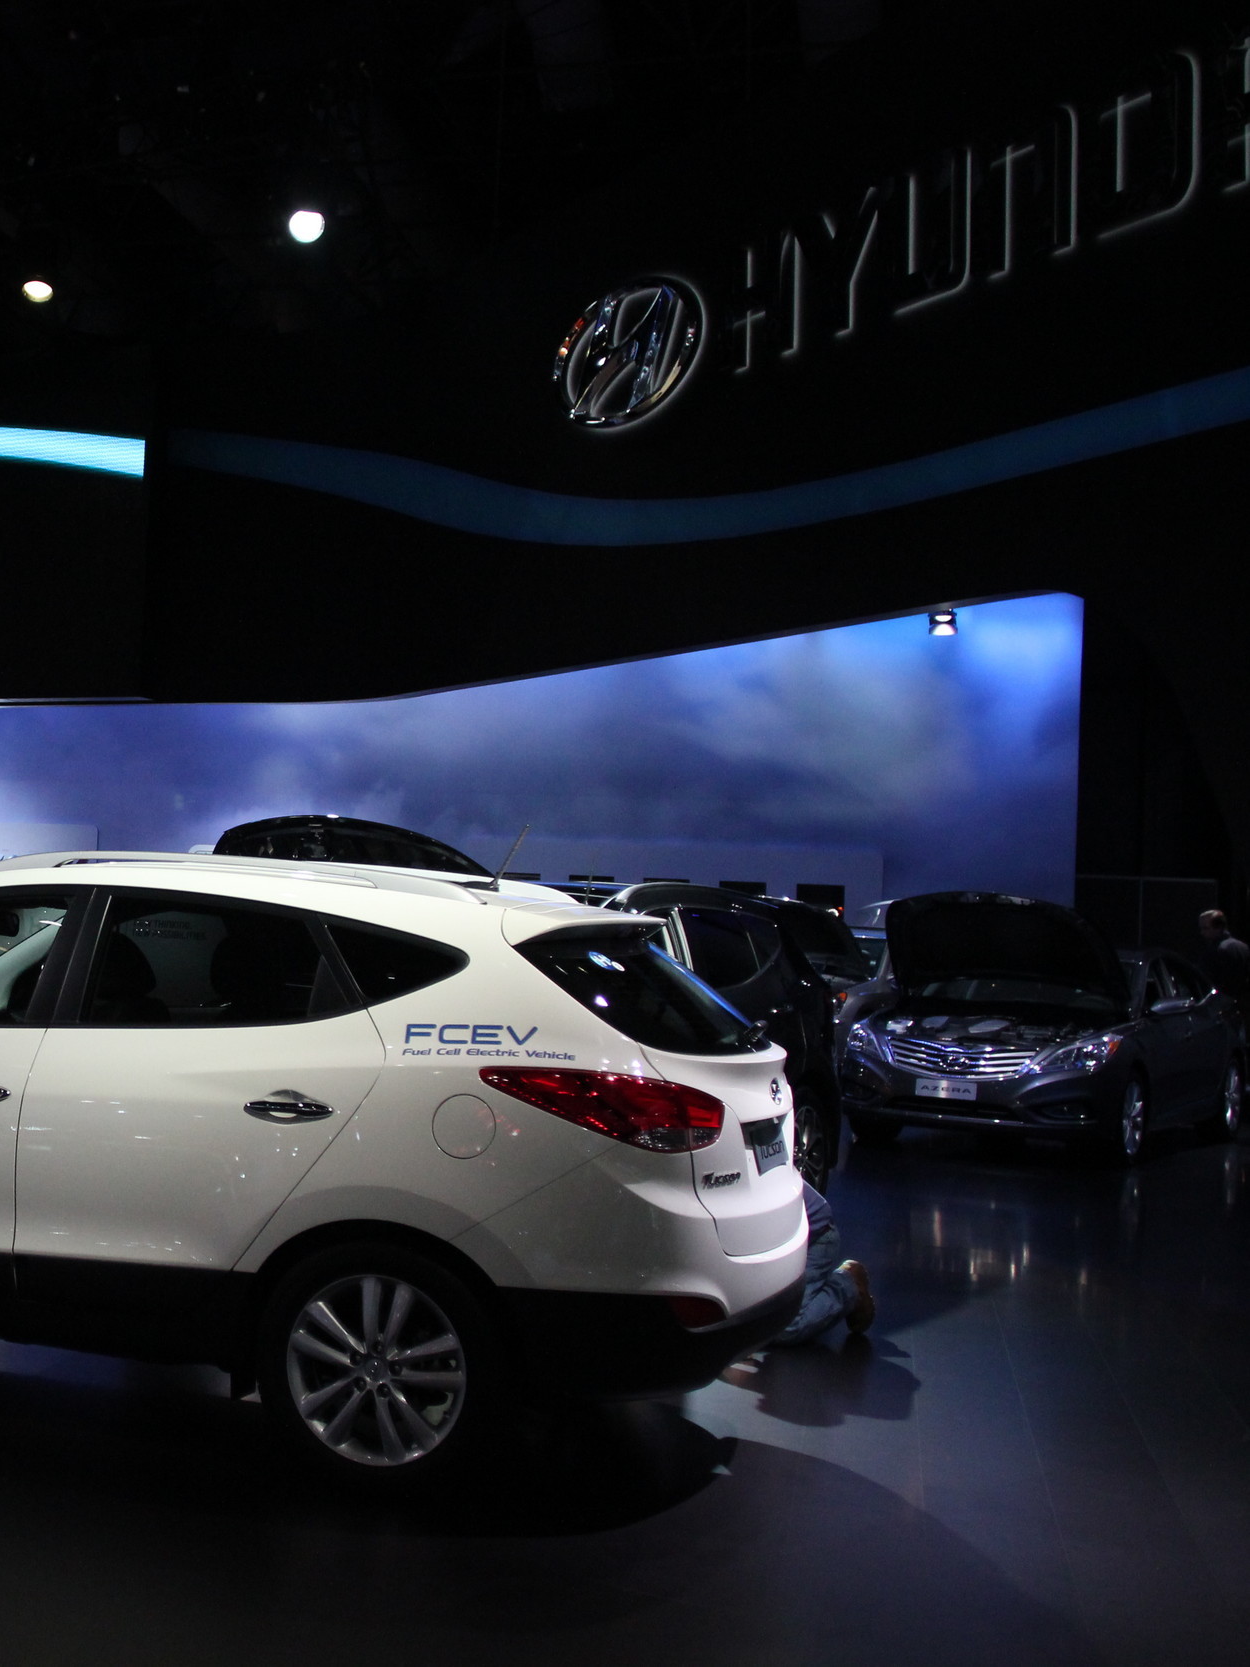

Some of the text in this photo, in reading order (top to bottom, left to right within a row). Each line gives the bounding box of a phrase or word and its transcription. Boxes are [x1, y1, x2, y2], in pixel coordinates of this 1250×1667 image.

[404, 1024, 538, 1046] FCEV
[402, 1048, 576, 1061] Fuel Cell Electric Vehicle
[921, 1084, 972, 1094] AZERA
